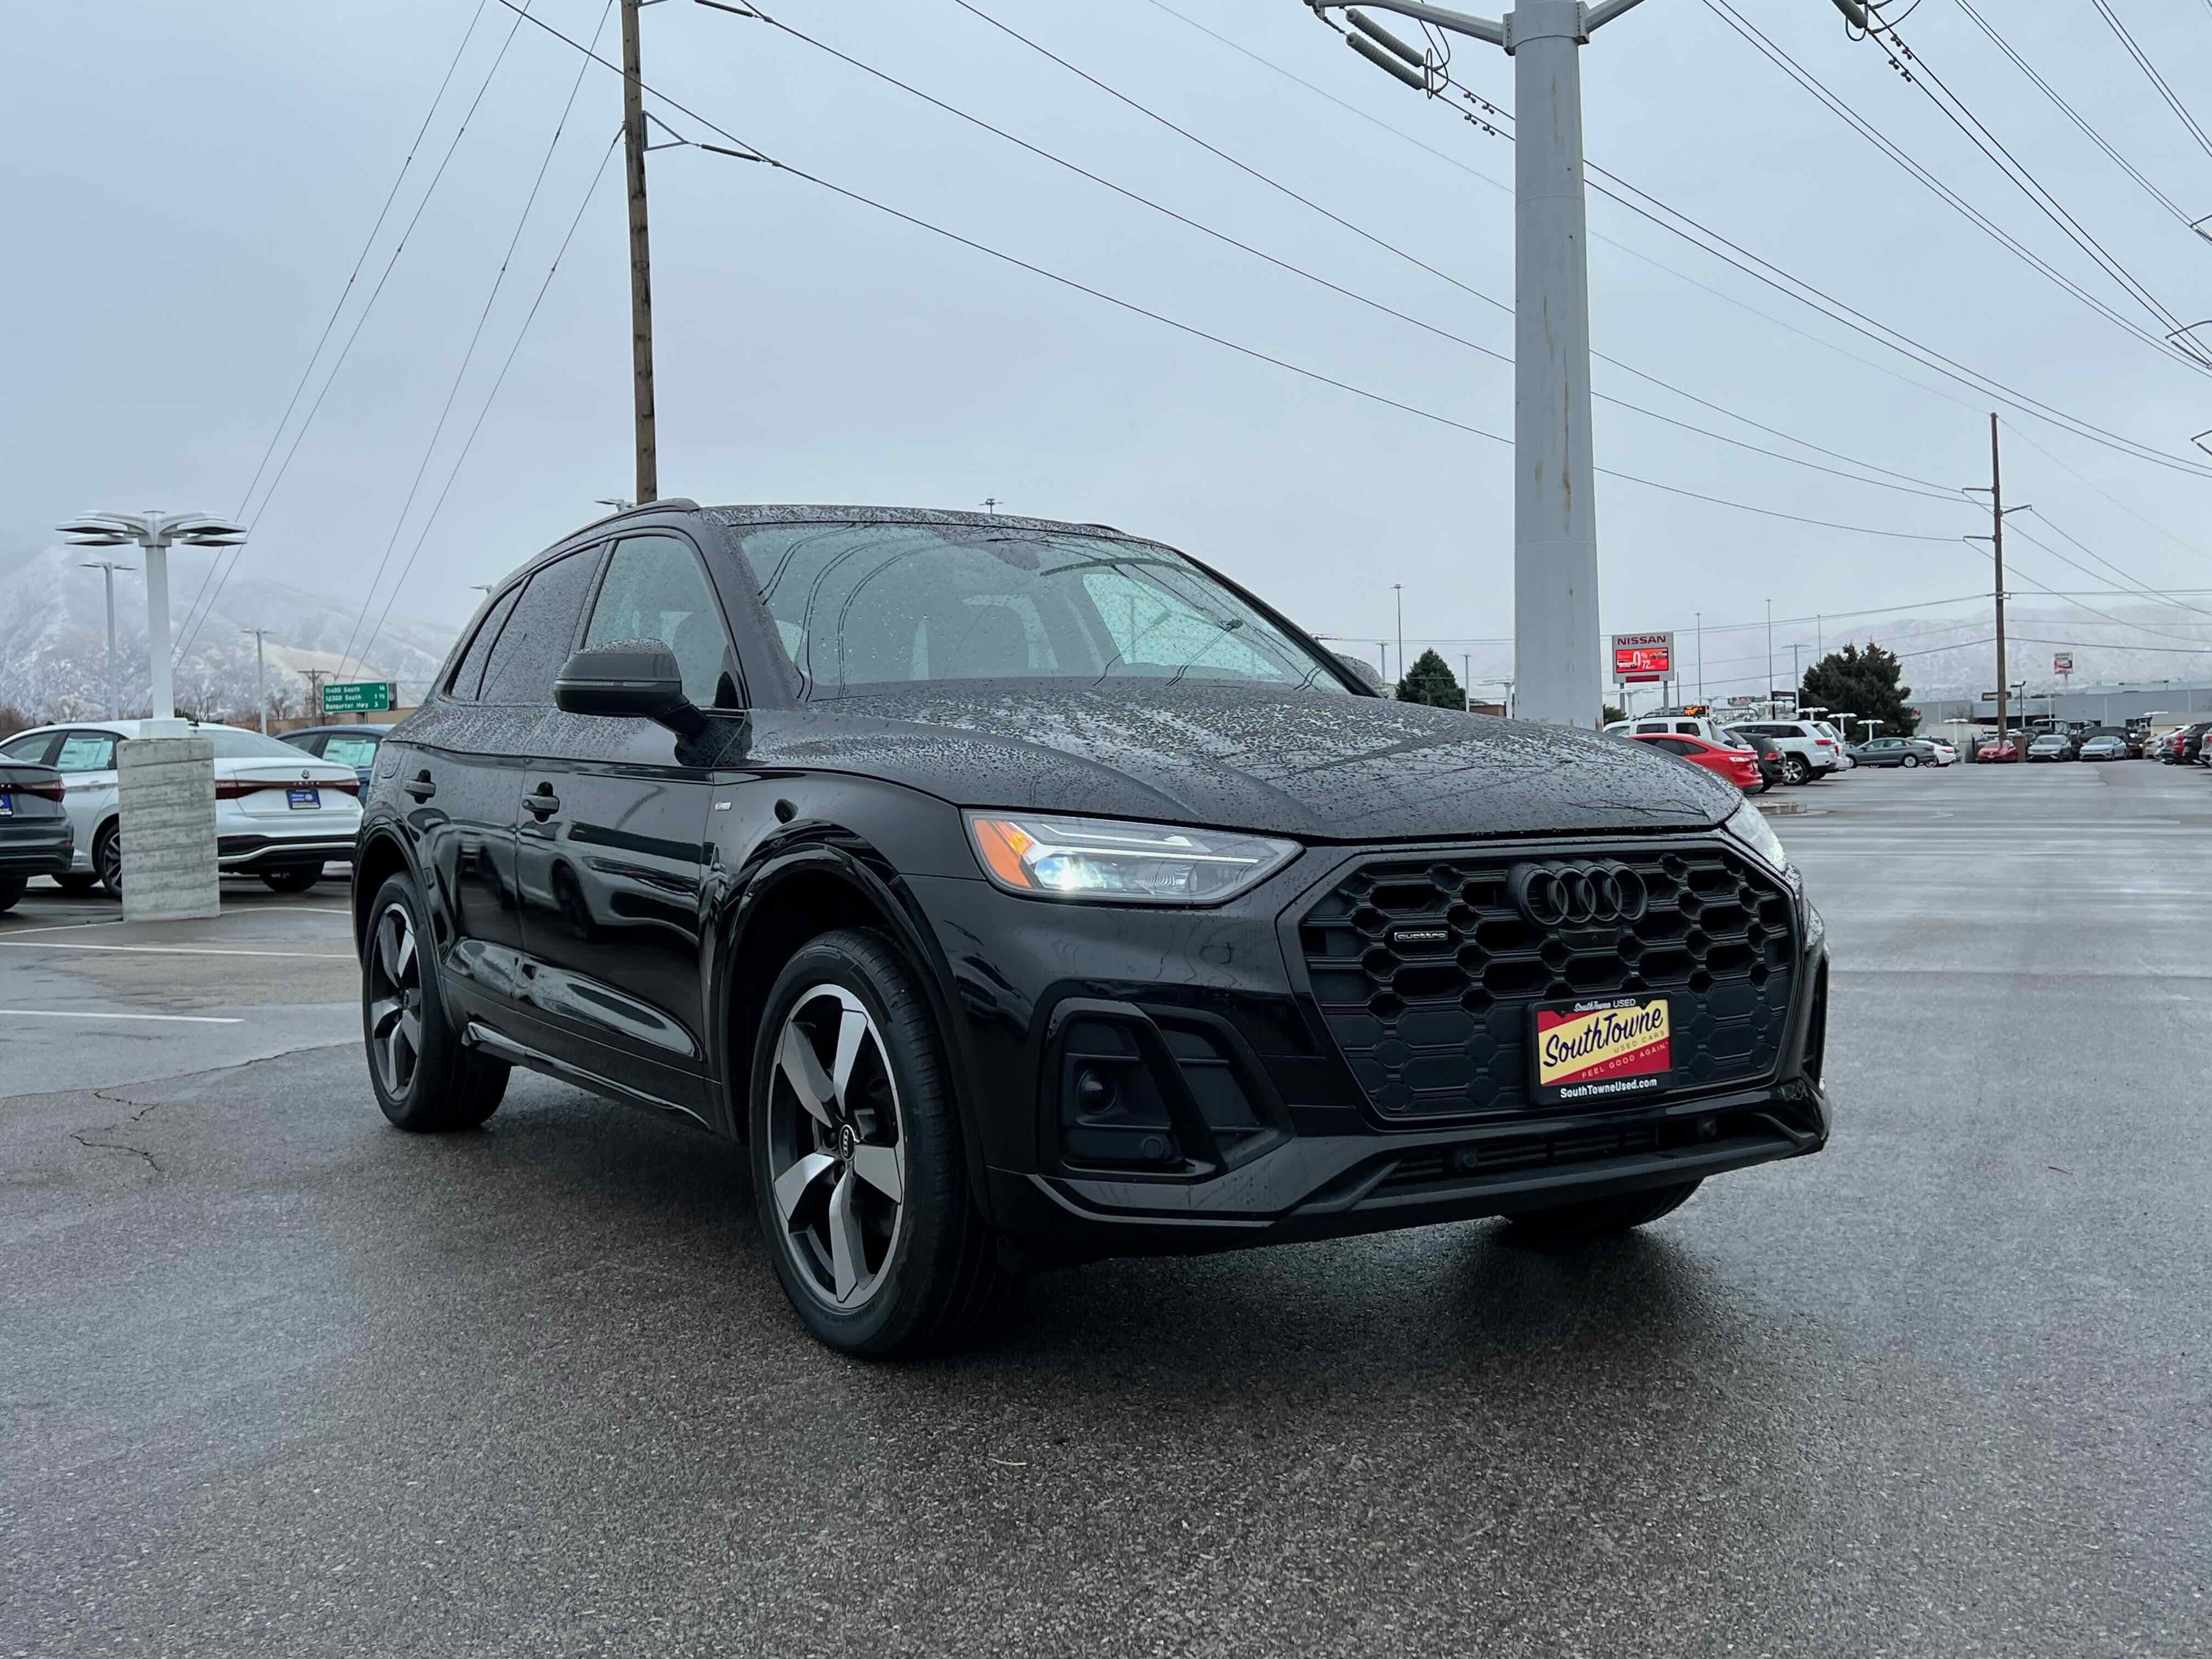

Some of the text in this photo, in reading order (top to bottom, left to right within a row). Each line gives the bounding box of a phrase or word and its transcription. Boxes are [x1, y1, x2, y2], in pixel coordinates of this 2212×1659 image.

[1617, 635, 1666, 645] NISSAN
[1613, 998, 1636, 1008] USED
[1614, 1030, 1664, 1053] USED CARS
[1582, 1066, 1605, 1079] FEEL
[1609, 1054, 1635, 1069] GOOD
[1560, 1078, 1657, 1098] SouthTowneUsed.com
